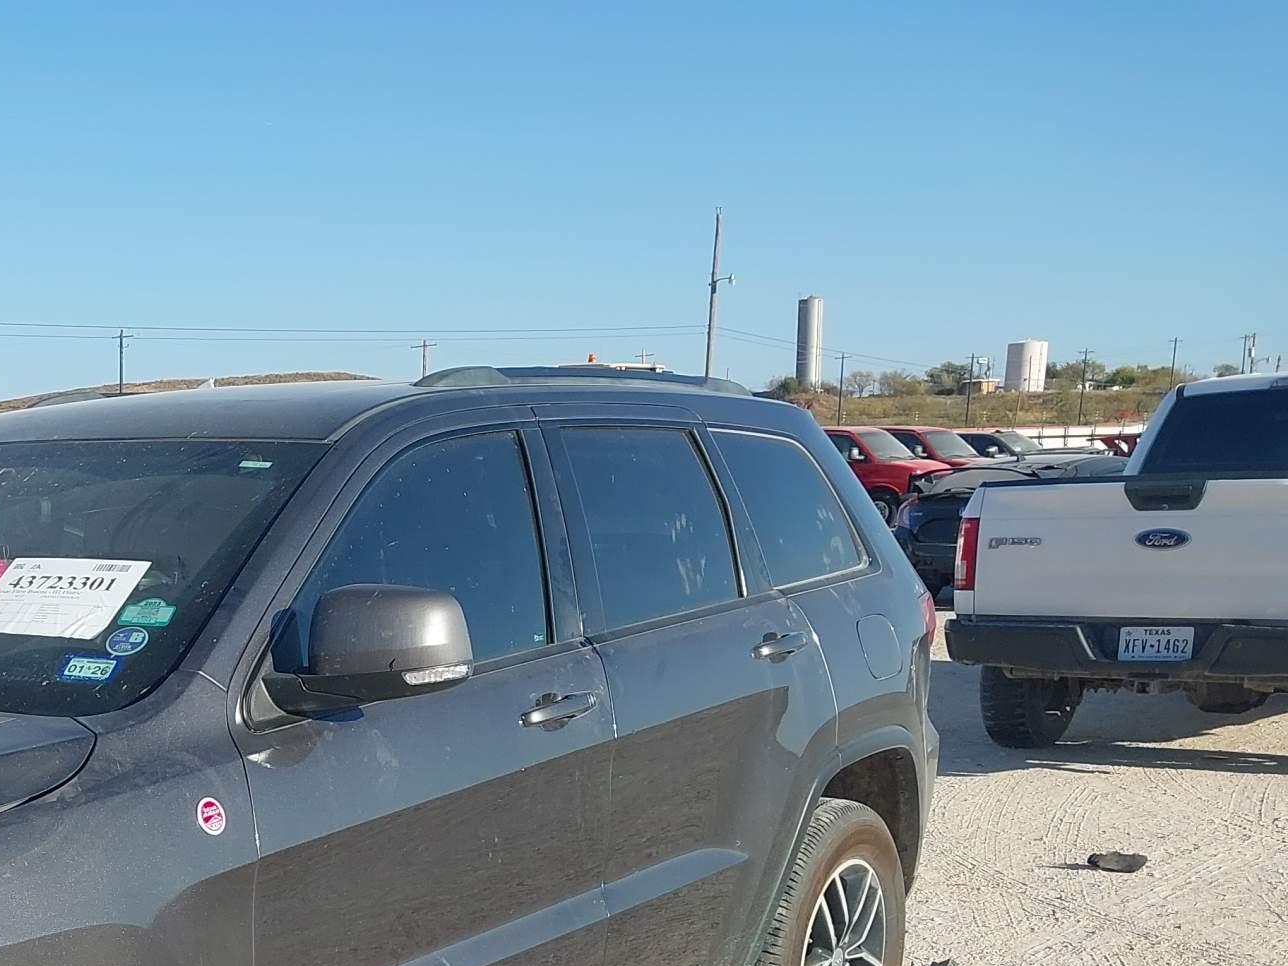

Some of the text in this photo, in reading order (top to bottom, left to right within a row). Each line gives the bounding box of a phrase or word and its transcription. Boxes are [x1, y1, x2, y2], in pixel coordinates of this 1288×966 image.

[8, 575, 117, 592] 43723301
[68, 664, 112, 676] 01 26
